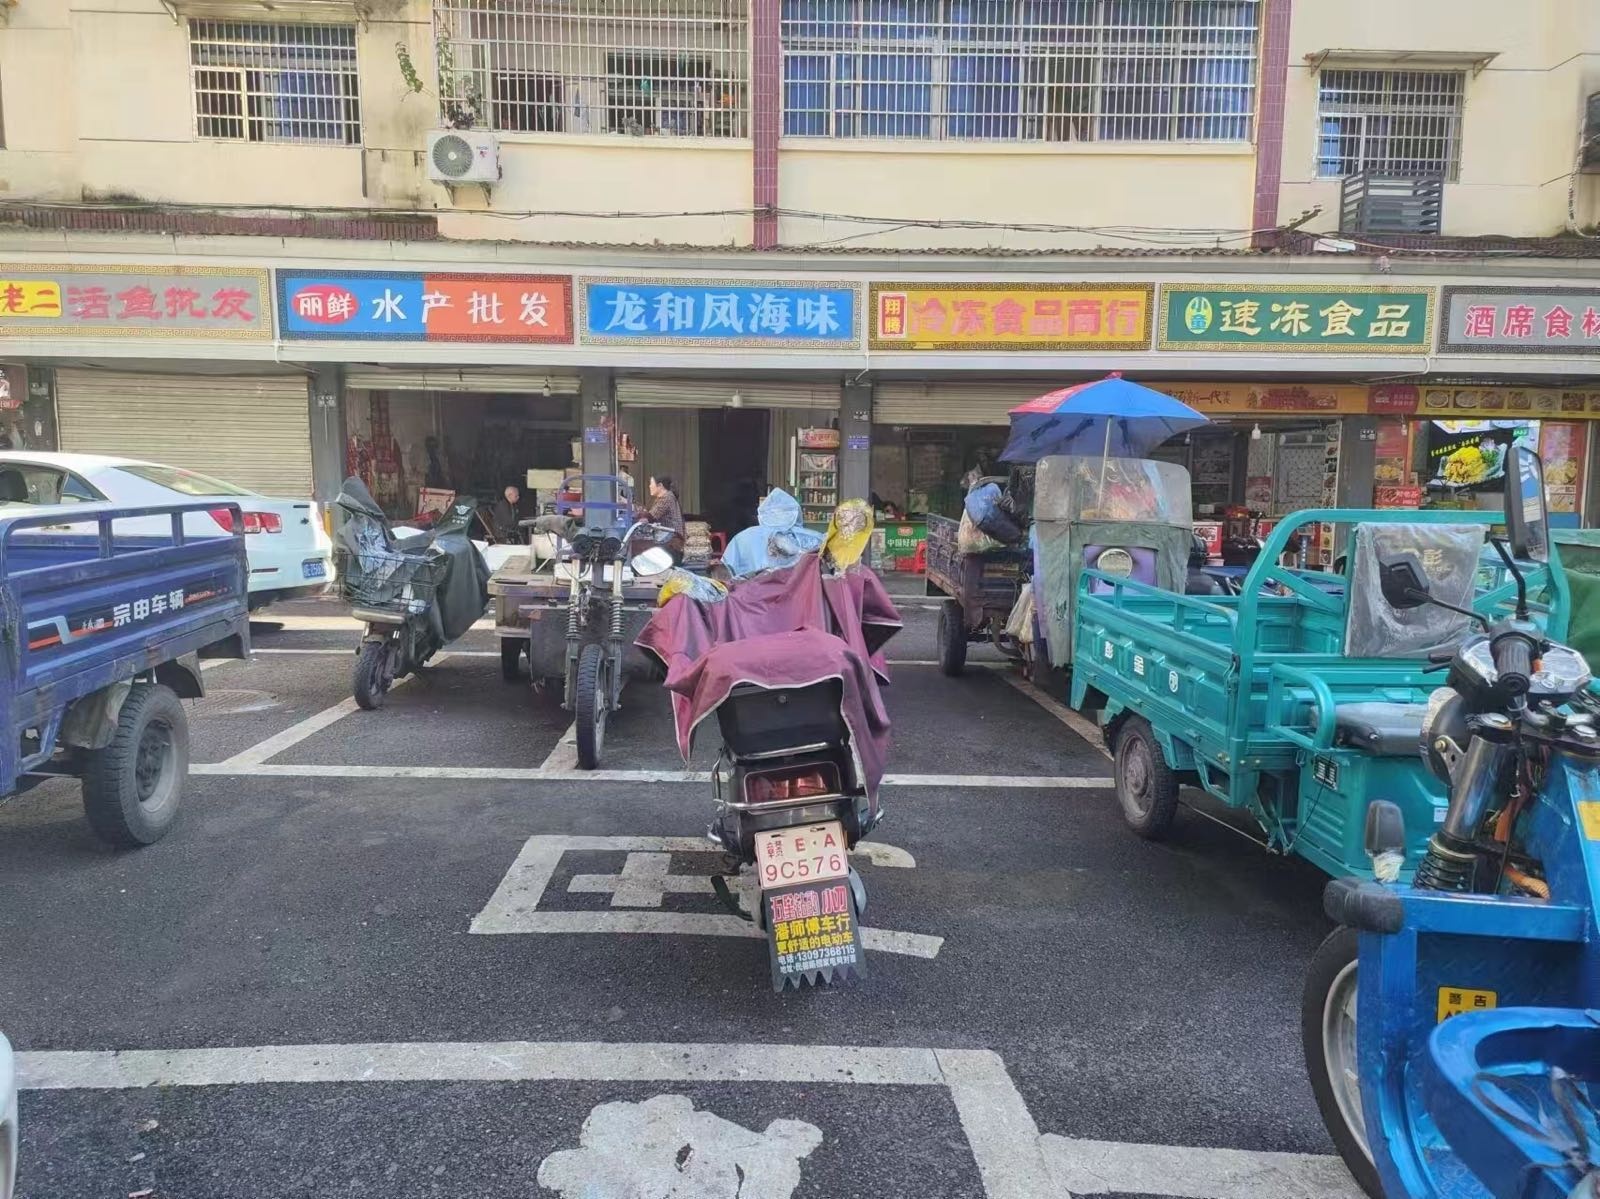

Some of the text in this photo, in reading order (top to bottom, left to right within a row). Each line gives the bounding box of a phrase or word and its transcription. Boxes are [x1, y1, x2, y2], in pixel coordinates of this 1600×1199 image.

[66, 285, 255, 321] 活鱼批发
[296, 293, 353, 320] 丽鲜
[371, 288, 552, 327] 水产批发
[604, 290, 840, 335] 龙和凤海味
[910, 297, 1141, 336] 冷冻食品商行
[1219, 299, 1412, 338] 速冻食品
[1464, 304, 1600, 338] 酒席食材
[113, 589, 185, 628] 宗申车辆
[765, 854, 842, 882] 9C576
